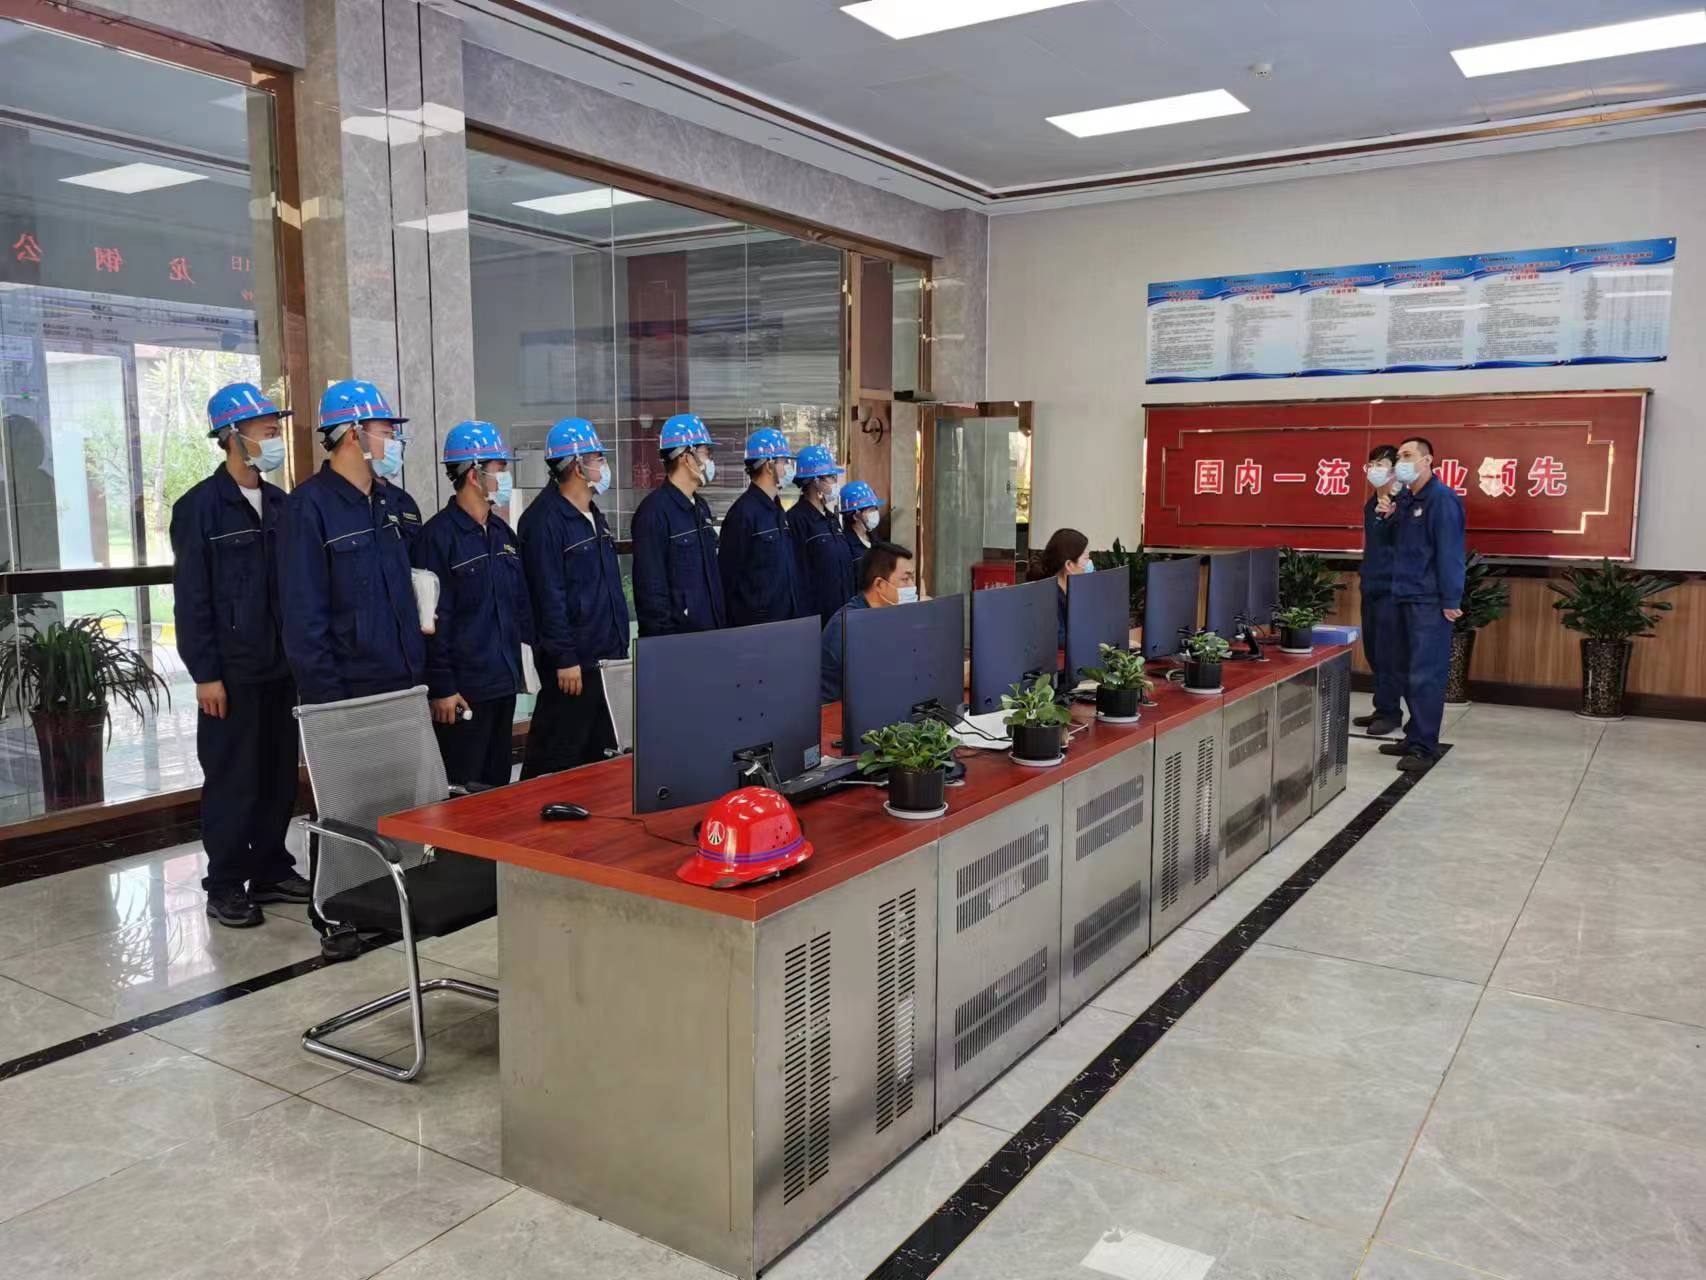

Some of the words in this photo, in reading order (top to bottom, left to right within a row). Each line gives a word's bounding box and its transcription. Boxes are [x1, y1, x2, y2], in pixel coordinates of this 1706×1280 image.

[1194, 458, 1350, 496] 国内一流
[1432, 456, 1567, 497] 业领先
